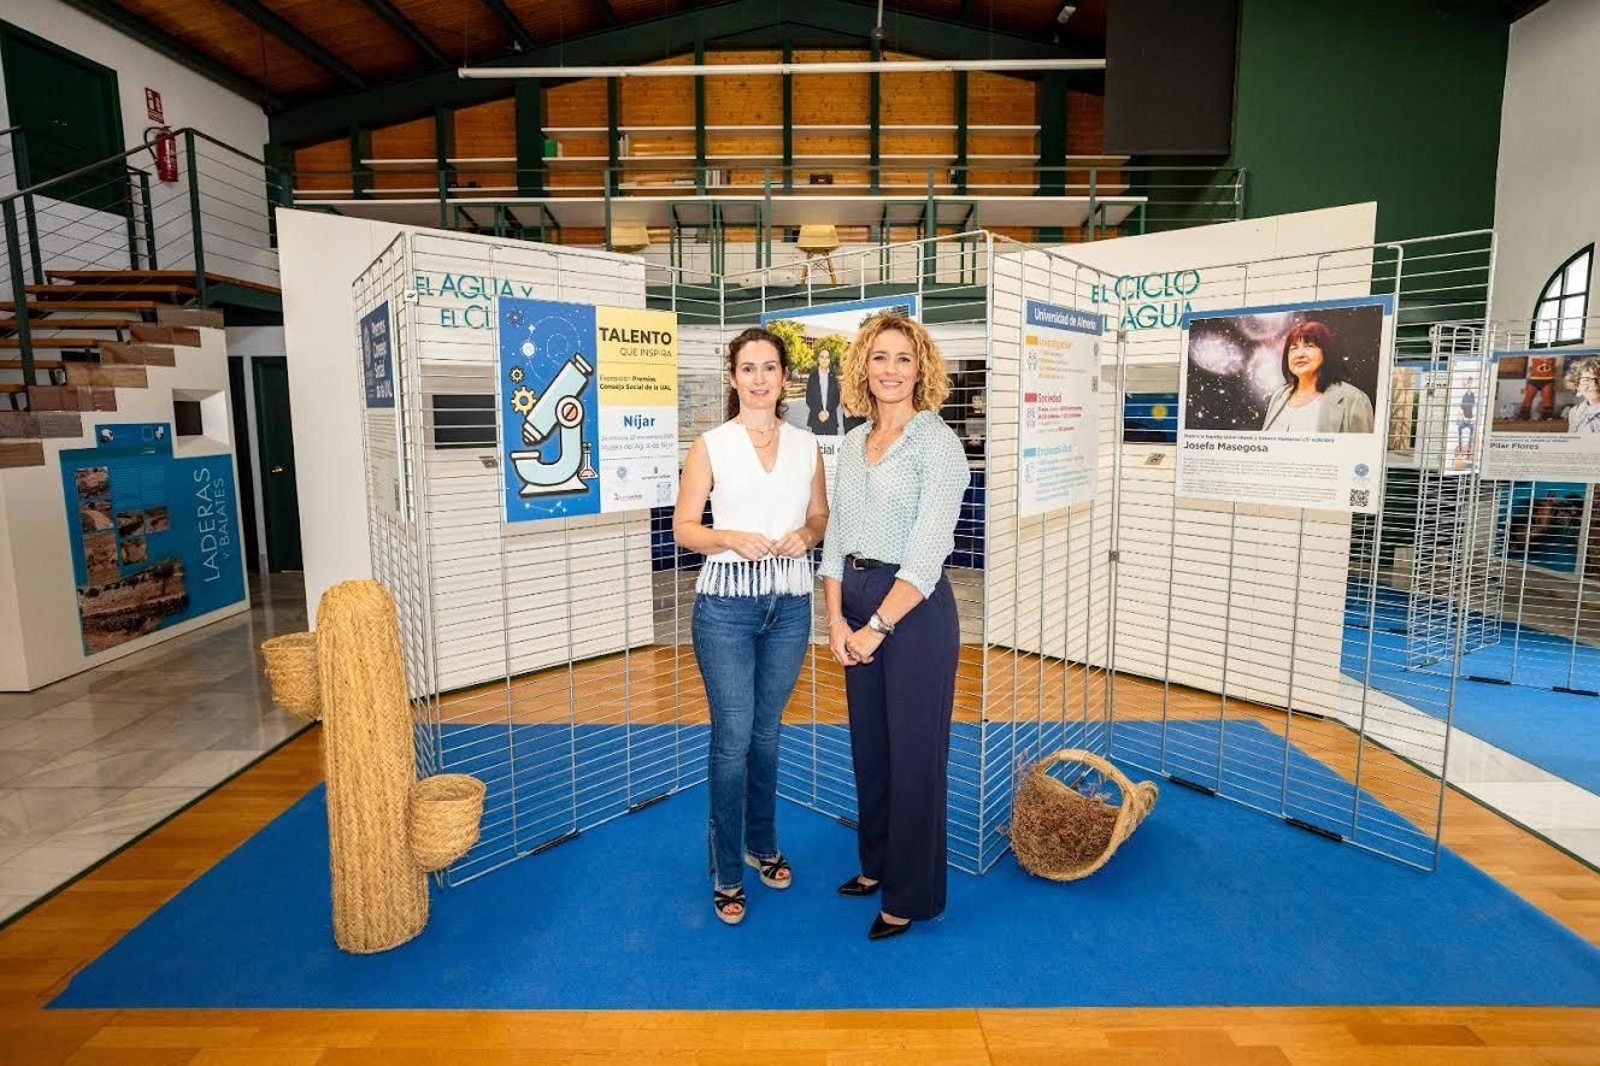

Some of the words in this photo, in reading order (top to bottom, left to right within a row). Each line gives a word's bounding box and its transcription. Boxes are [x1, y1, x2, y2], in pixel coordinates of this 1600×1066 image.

[415, 276, 434, 296] EL
[440, 273, 514, 300] AGUA
[1091, 284, 1108, 303] EL
[1115, 269, 1200, 301] CICLO
[440, 308, 459, 328] EL
[1034, 307, 1069, 325] Universidad
[1069, 314, 1076, 327] de
[599, 327, 672, 345] TALENTO
[619, 347, 638, 357] QUE
[640, 348, 672, 357] INSPIRA
[600, 383, 625, 391] Consejo
[632, 375, 656, 383] Premios
[623, 414, 656, 429] Níjar
[1183, 441, 1215, 450] Josefa
[1217, 442, 1269, 454] Masegosa
[1489, 442, 1509, 451] Pilar
[1511, 442, 1540, 451] Flores
[212, 477, 231, 548] BALATES
[193, 467, 220, 583] LADERAS
